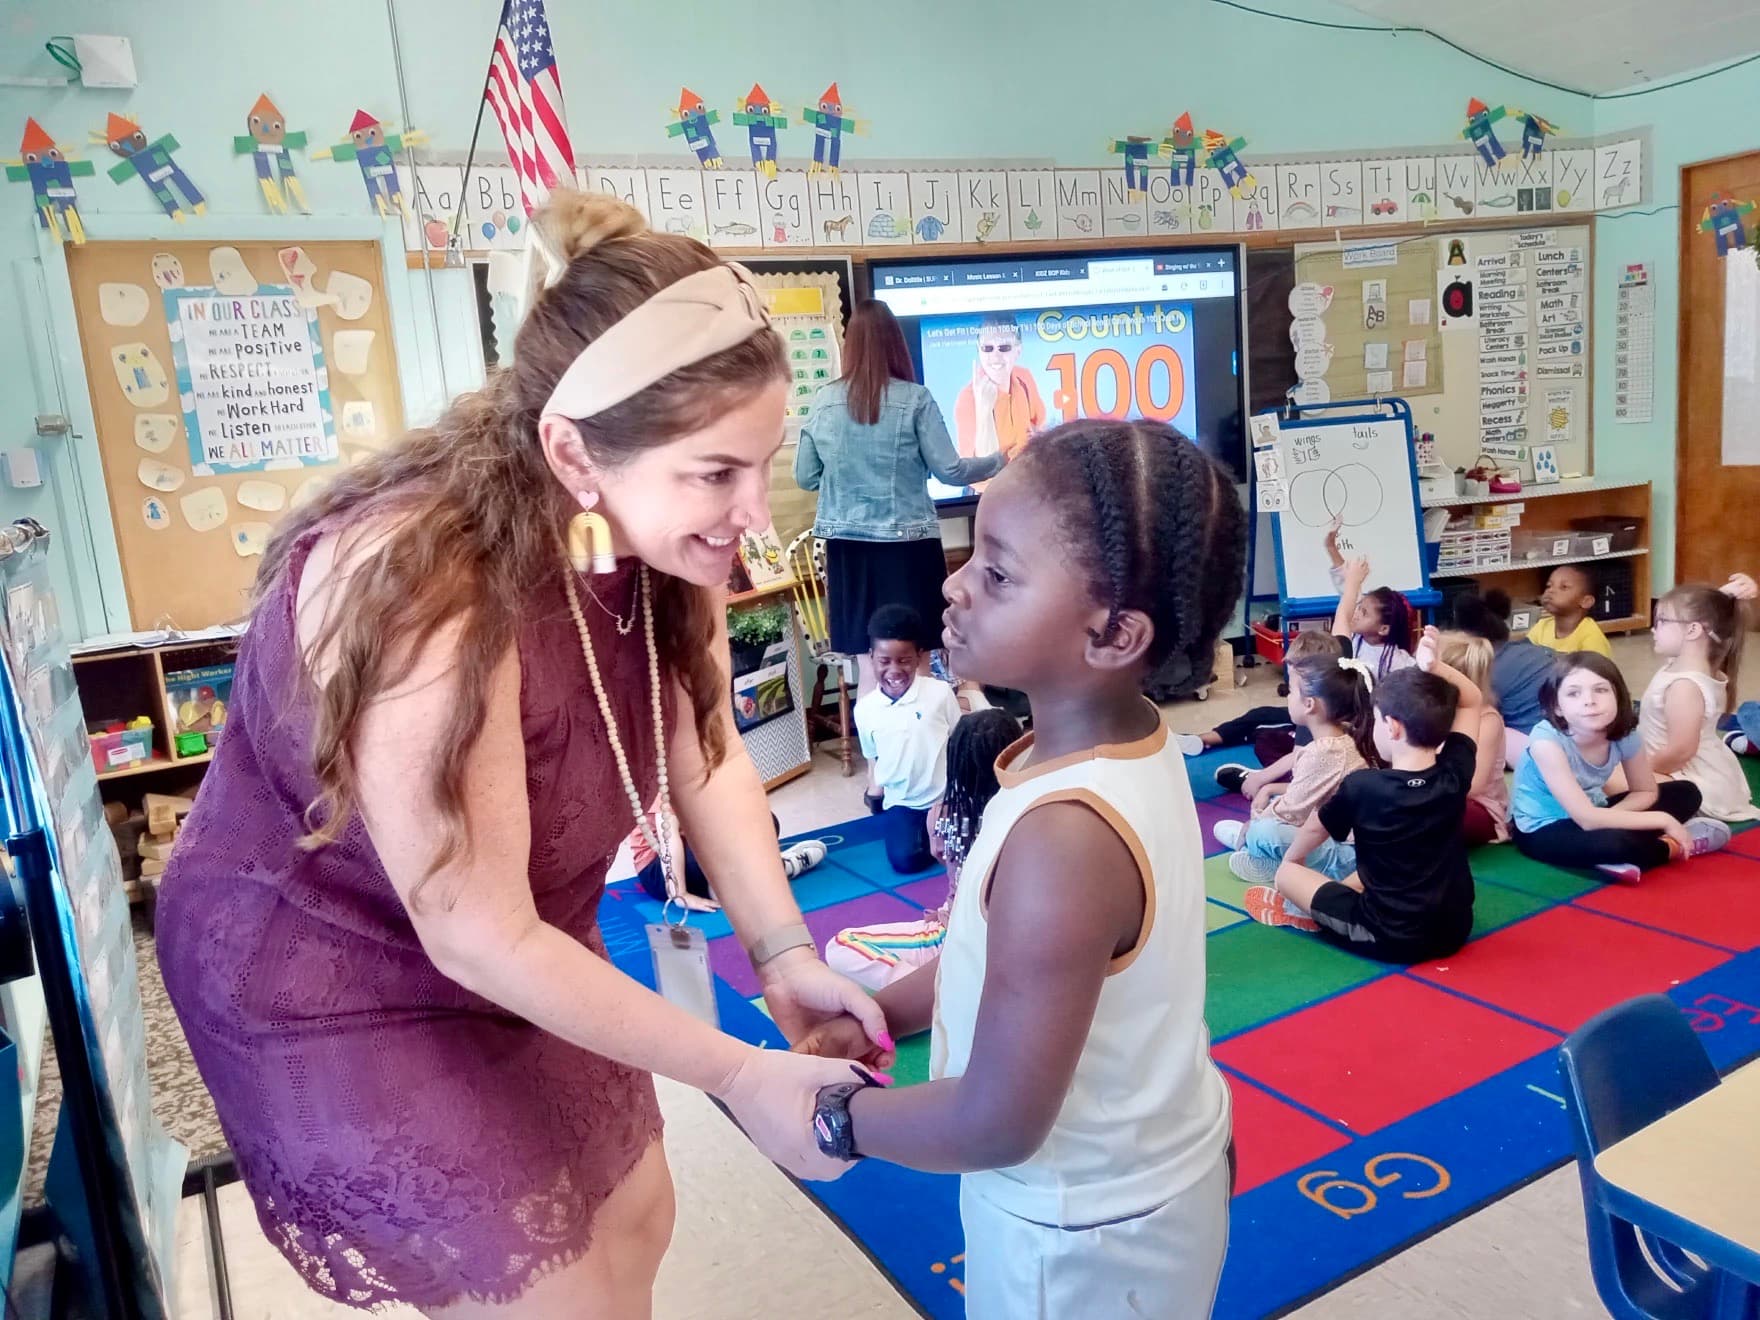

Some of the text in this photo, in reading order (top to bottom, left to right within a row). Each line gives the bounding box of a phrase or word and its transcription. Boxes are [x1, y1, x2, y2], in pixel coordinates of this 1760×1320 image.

[412, 176, 451, 209] Aa
[479, 176, 515, 209] Bb
[659, 177, 693, 210] Ee
[715, 179, 743, 210] Ff
[765, 179, 800, 228] Gg
[817, 180, 852, 211] Hh
[873, 181, 893, 211] Ii
[924, 180, 950, 226] Jj
[970, 179, 999, 209] Kk
[1019, 179, 1042, 207] Ll
[1059, 179, 1098, 206] Mm
[1150, 176, 1184, 203] Oo
[1201, 176, 1222, 216] Pp
[1288, 172, 1313, 198] Rr
[1329, 169, 1353, 196] Ss
[1369, 167, 1392, 194] Tt
[1406, 165, 1435, 191] Uu
[1443, 164, 1468, 189] Vv
[1478, 162, 1516, 187] Ww
[1522, 157, 1547, 185] Xx
[1560, 157, 1587, 196] Yy
[1603, 151, 1631, 179] Zz
[1344, 249, 1395, 261] Work Board
[1539, 251, 1564, 261] Lunch
[1478, 257, 1506, 266] Arrival
[1536, 268, 1568, 276] Centers
[1478, 289, 1515, 300] Reading
[188, 299, 301, 320] IN OUR CLASS
[1541, 299, 1563, 309] Math
[1036, 303, 1187, 342] Count to
[1542, 314, 1556, 322] Art
[241, 323, 285, 339] TEAM
[970, 326, 989, 336] Count
[1558, 345, 1568, 353] Up
[209, 362, 272, 380] RESPECT
[1537, 366, 1570, 375] Dismissal
[1046, 344, 1184, 422] 100
[222, 383, 252, 399] kind
[267, 381, 313, 396] honest
[1481, 385, 1516, 395] Phonics
[227, 400, 268, 419] Work
[270, 398, 304, 415] Hard
[1482, 399, 1516, 409] Heggerty
[1482, 416, 1512, 425] Recess
[221, 422, 271, 439] Listen
[1294, 426, 1378, 448] wings tails
[208, 436, 322, 459] WE ALL MATTER
[1336, 538, 1354, 550] oth
